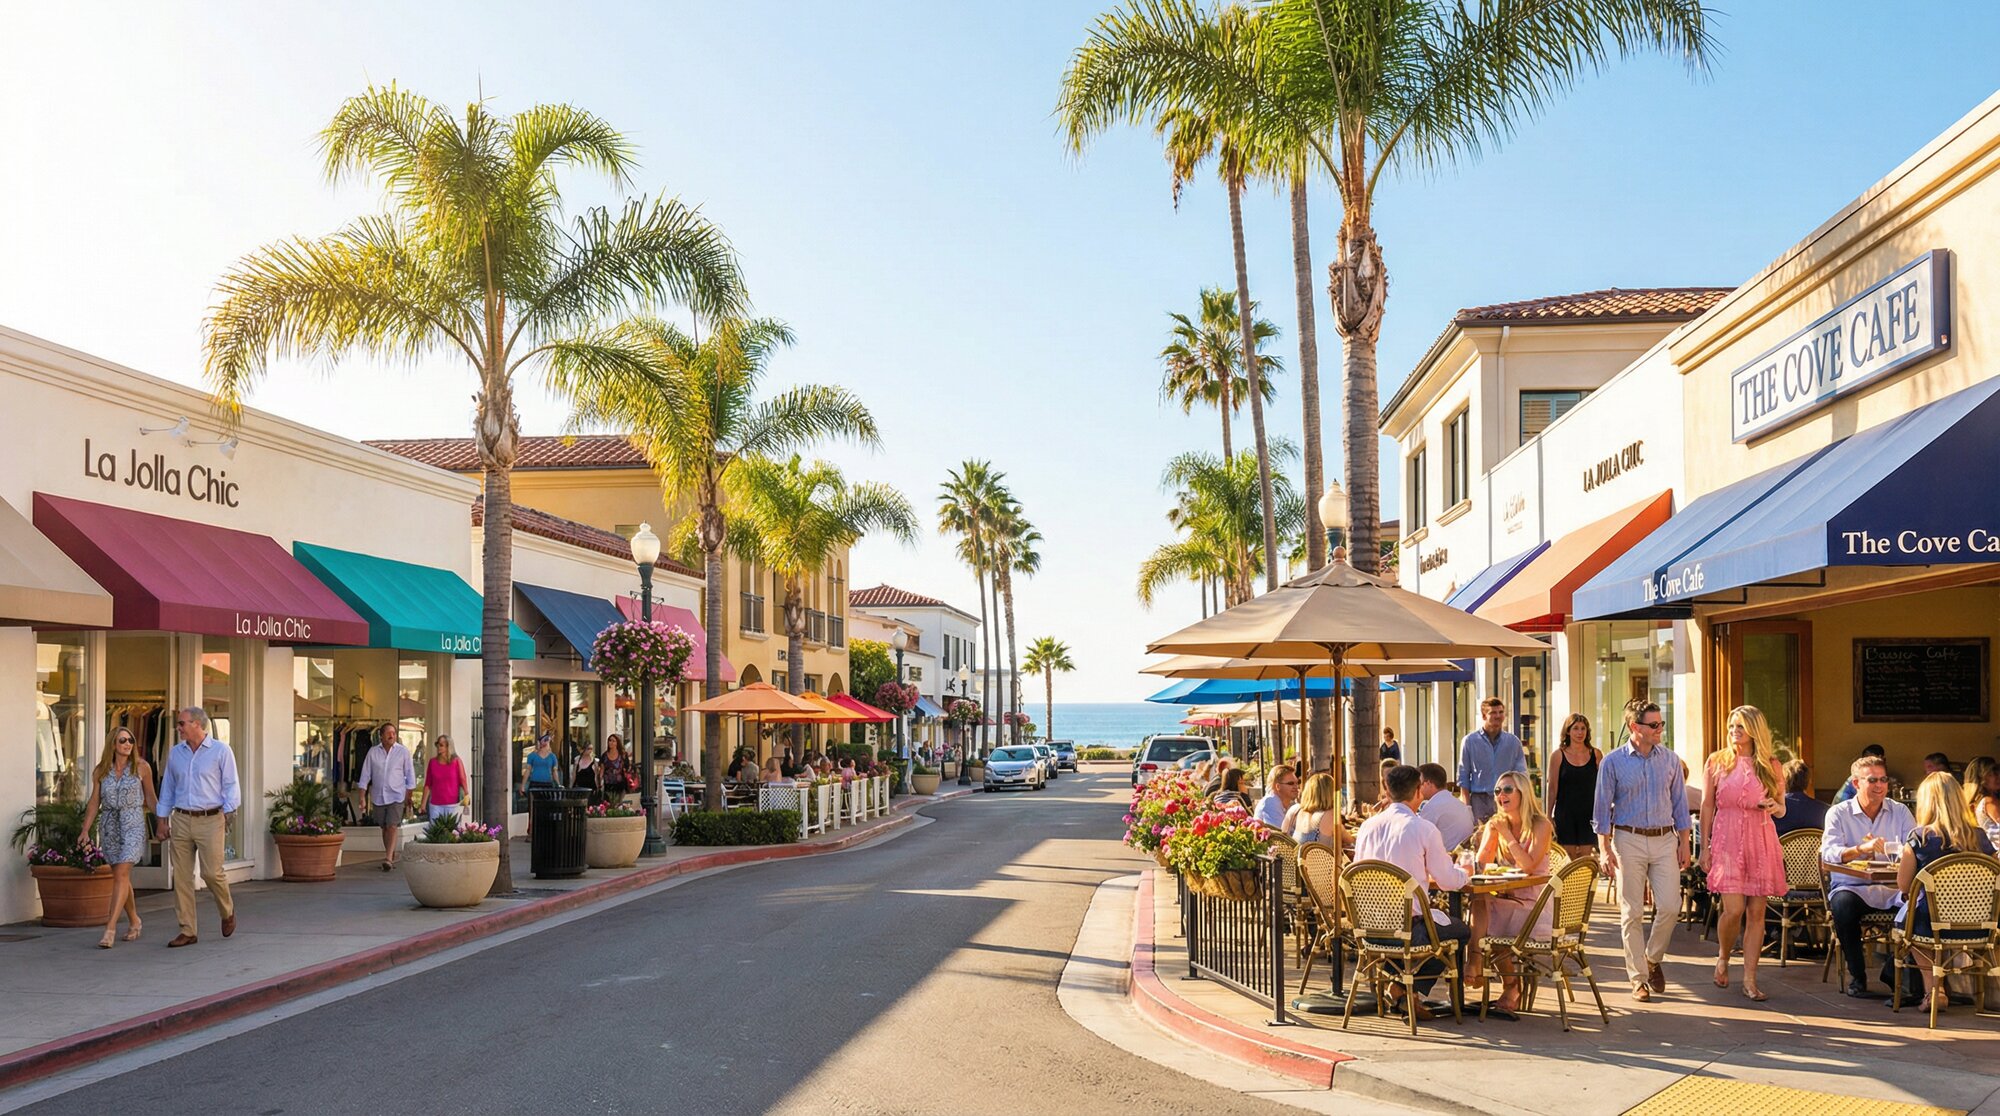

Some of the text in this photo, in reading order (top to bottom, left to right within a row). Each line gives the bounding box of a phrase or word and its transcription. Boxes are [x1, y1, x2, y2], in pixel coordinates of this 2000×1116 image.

[1739, 280, 1921, 425] THE COVE CAFE
[84, 438, 240, 508] La Jolla Chic
[1583, 468, 1595, 493] LA
[1842, 530, 1891, 554] The
[1897, 530, 1961, 553] Cove
[1643, 575, 1659, 602] The
[1660, 574, 1681, 598] Cove
[235, 613, 311, 639] La Jolla Chic
[441, 633, 452, 650] La
